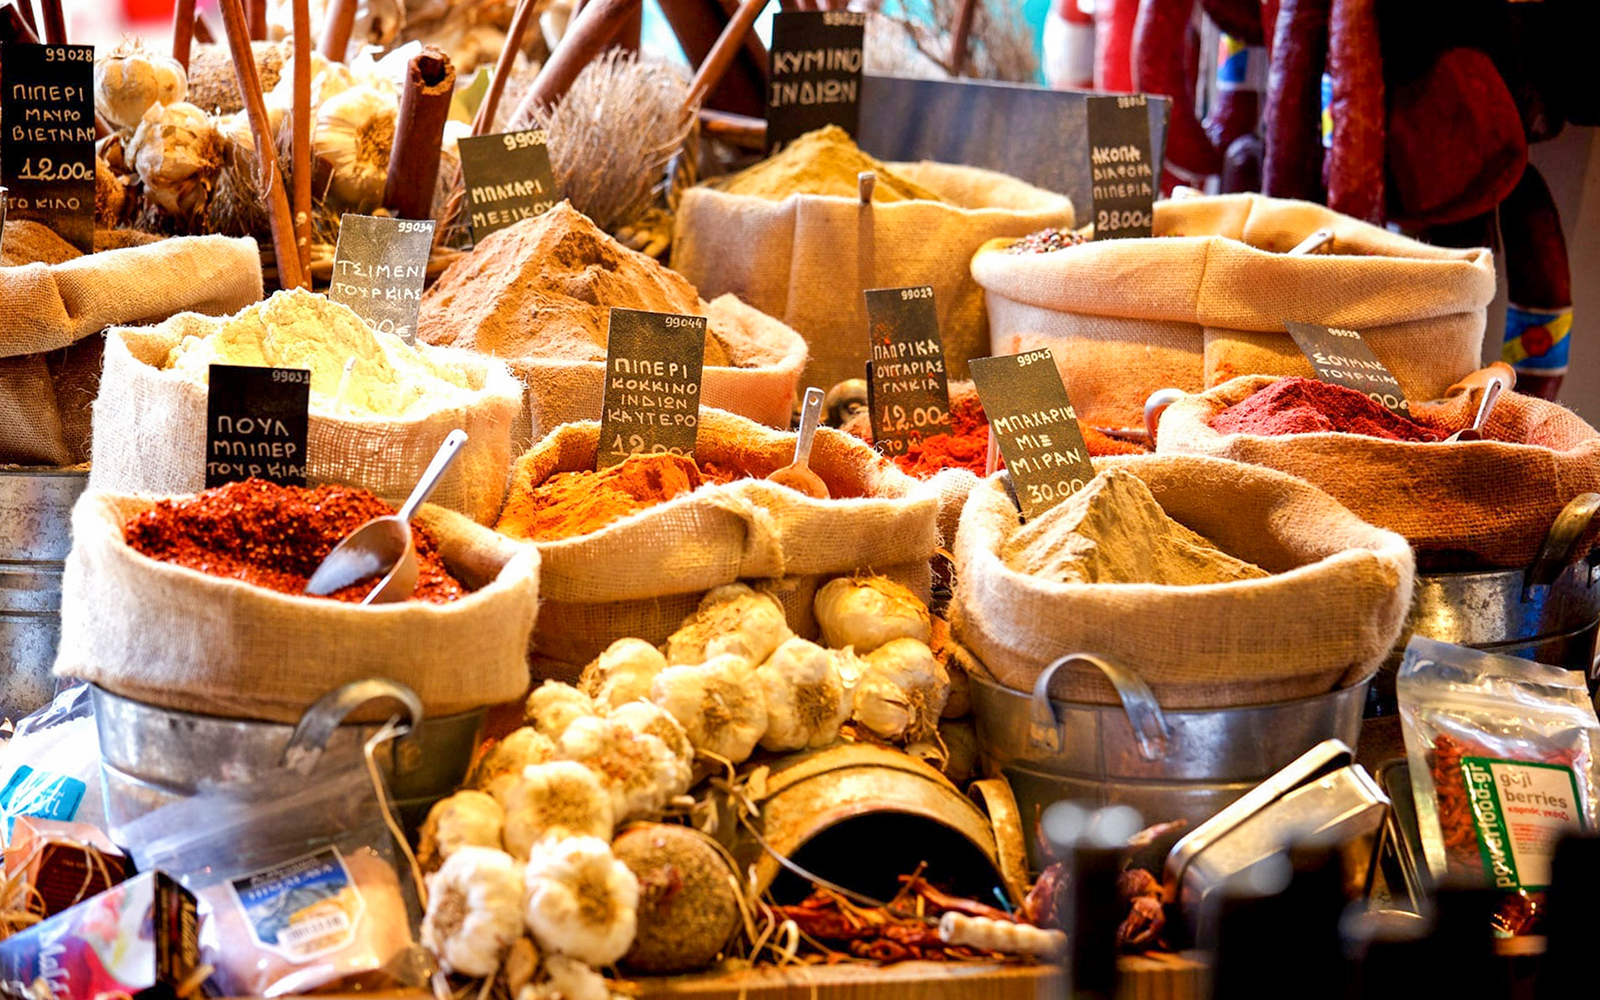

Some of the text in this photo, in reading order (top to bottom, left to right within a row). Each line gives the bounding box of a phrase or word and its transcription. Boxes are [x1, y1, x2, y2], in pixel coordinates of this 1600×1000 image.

[46, 48, 93, 62] 99028
[773, 48, 862, 75] ΚΥΜΙΝΟ
[13, 84, 84, 102] ΠΙΠΕΡΙ
[770, 80, 857, 107] ΙΝΔΙΩΝ
[25, 108, 81, 122] ΜΑΥΡΟ
[12, 125, 96, 142] ΒΙΕΤΝΑΜ
[1091, 145, 1141, 165] ΑΚΟΠΑ
[1093, 163, 1152, 181] ΔΙΑΦΟΡΑ
[472, 178, 543, 204] ΜΠΑΧΑΡΙ
[1093, 182, 1152, 200] ΠΙΠΕΡΙΑ
[7, 197, 80, 210] ΤΟ ΚΙΛΟ
[471, 200, 554, 228] ΜΕΞΙΚΟΥ
[398, 221, 433, 233] 99034
[337, 260, 426, 278] ΤΣΙΜΕΝΙ
[335, 283, 421, 300] ΤΟΥΡΚΙΑΣ
[901, 286, 934, 301] 99027
[665, 316, 702, 329] 99044
[873, 338, 941, 361] ΠΑΠΡΙΚΑ
[1016, 348, 1052, 367] 99045
[614, 357, 688, 379] ΠΙΠΕΡΙ
[876, 360, 944, 379] ΟΥΓΓΑΡΙΑΣ
[1312, 352, 1387, 372] ΣΟΥΜΑΚ
[611, 377, 698, 395] ΚΟΚΚΙΝΟ
[620, 394, 688, 410] ΙΝΔΙΩΝ
[217, 415, 289, 437] ΠΟΥΛ
[607, 408, 697, 427] ΚΑΥΤΕΡΟ
[213, 440, 297, 458] ΜΠΙΠΕΡ
[1015, 434, 1053, 451] ΜΙΞ
[207, 461, 307, 478] ΤΟΥΡΚΙΑΣ
[1010, 447, 1083, 477] ΜΙΡΑΝ
[1504, 789, 1568, 809] berries
